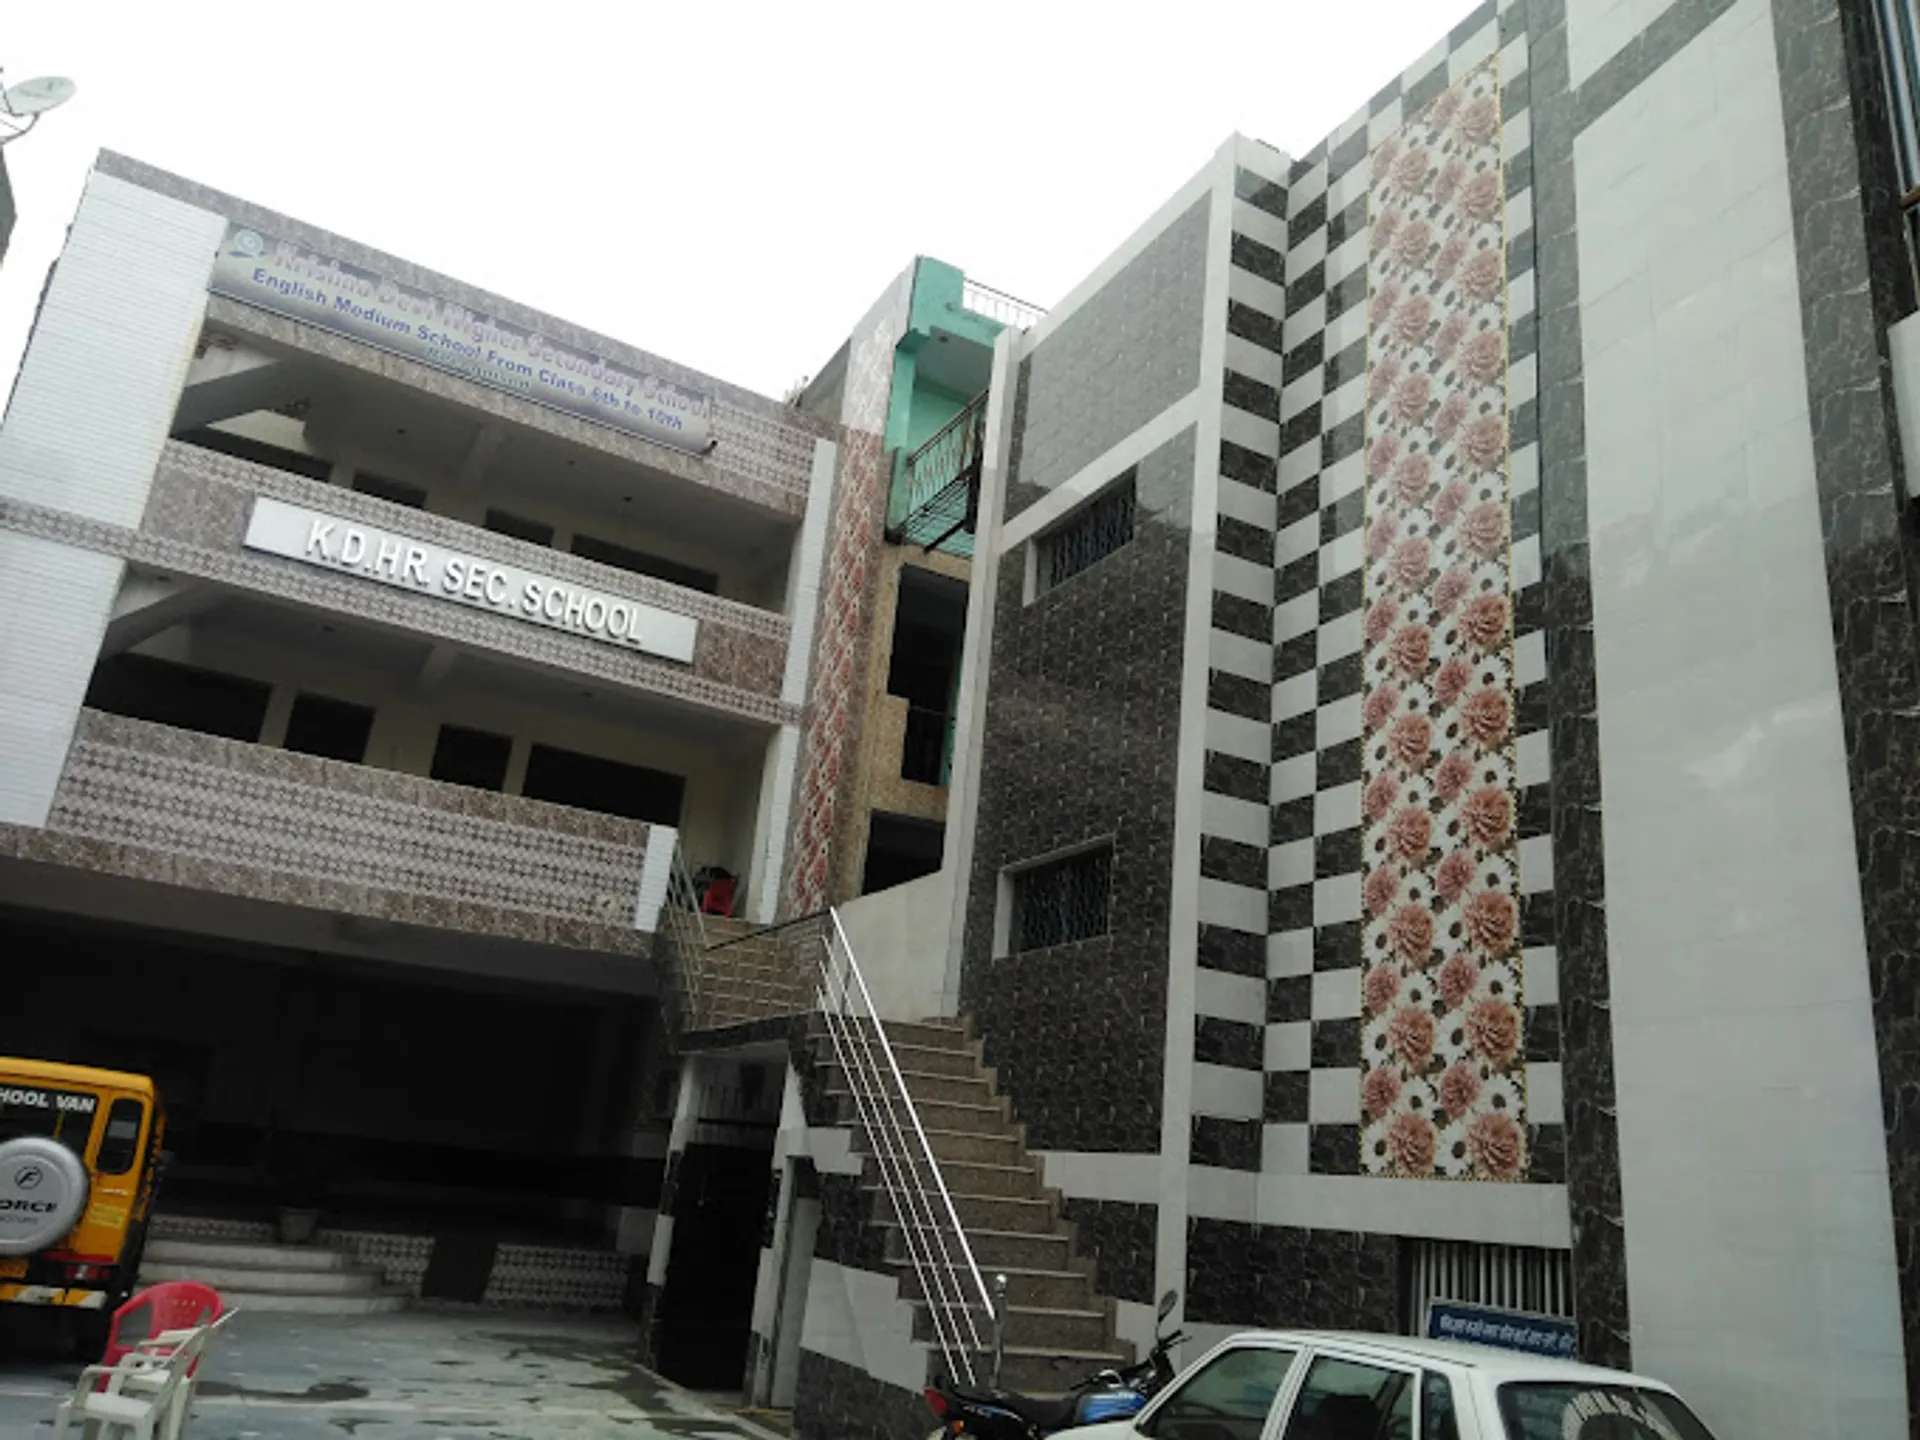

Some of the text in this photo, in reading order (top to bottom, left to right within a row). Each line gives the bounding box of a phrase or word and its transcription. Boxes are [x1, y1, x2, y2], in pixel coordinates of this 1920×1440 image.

[252, 267, 327, 306] English
[417, 323, 481, 358] School
[487, 349, 533, 377] From
[442, 552, 515, 609] SEC.
[522, 577, 643, 646] SCHOOL
[56, 1095, 96, 1113] VAN
